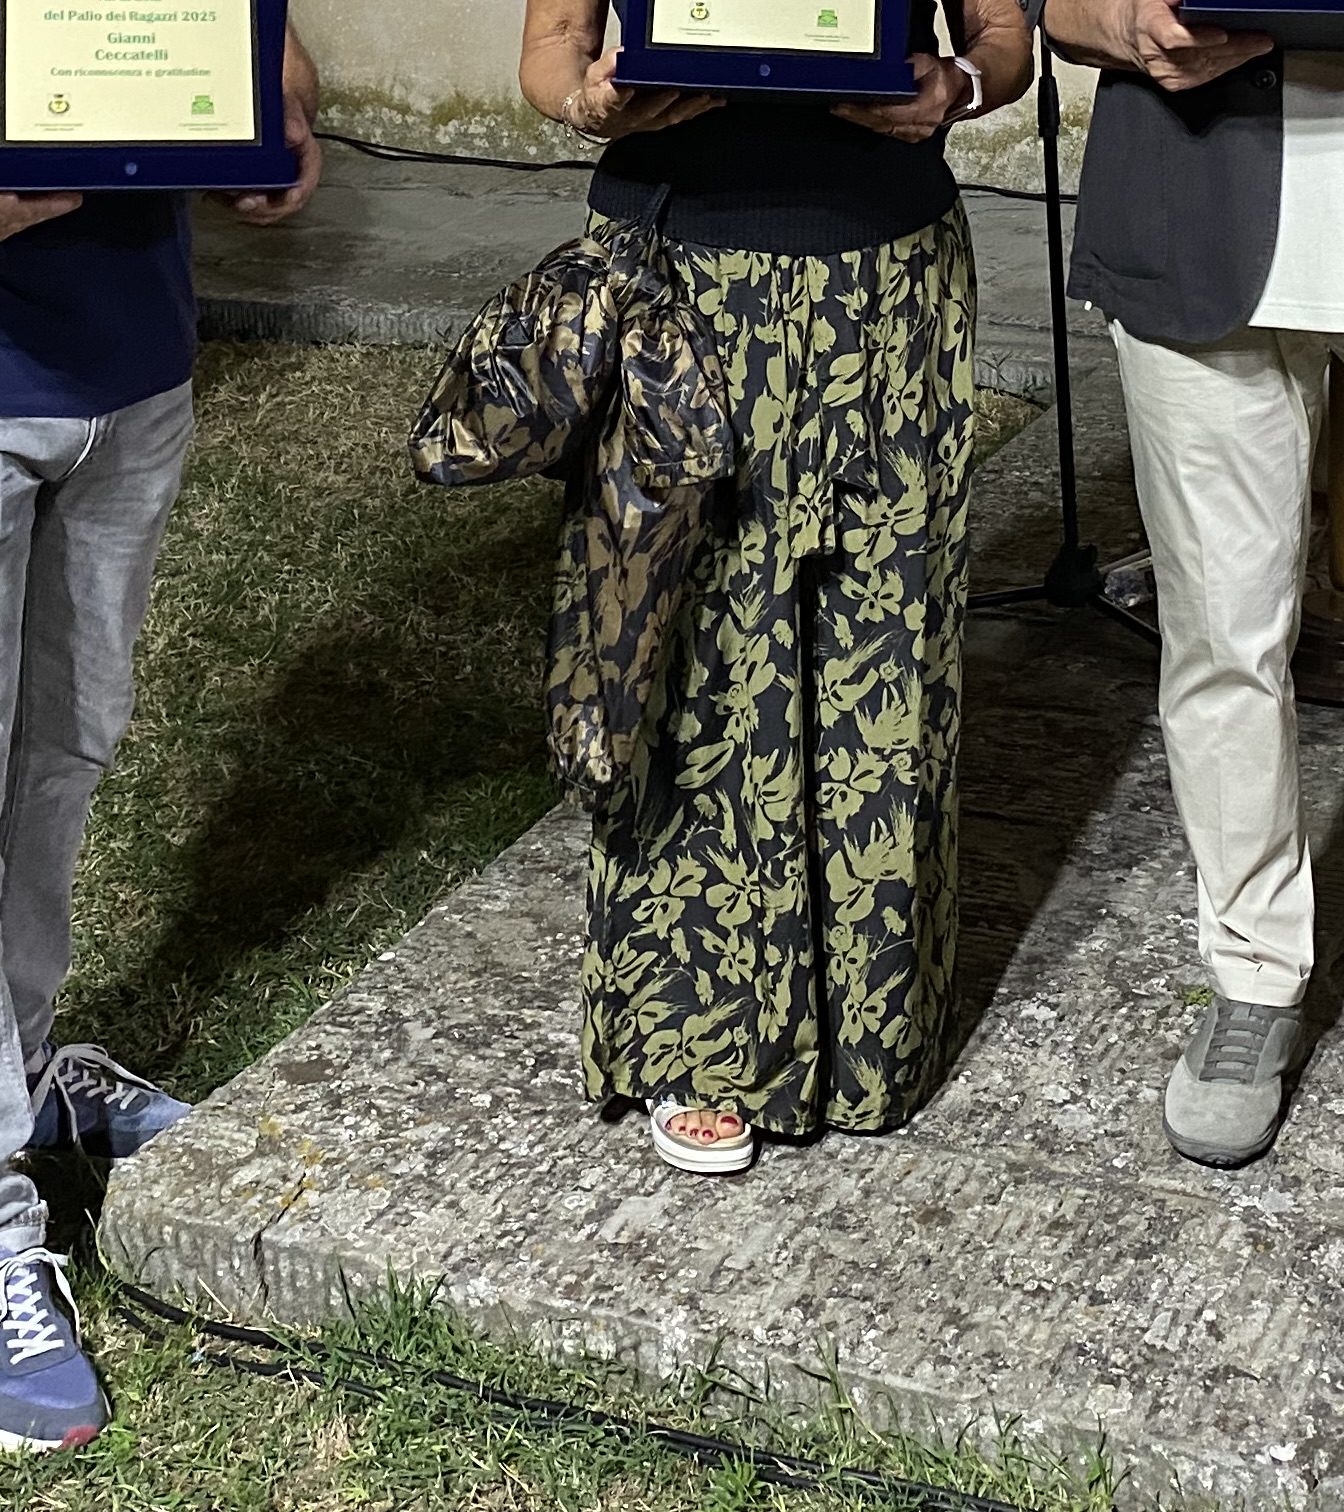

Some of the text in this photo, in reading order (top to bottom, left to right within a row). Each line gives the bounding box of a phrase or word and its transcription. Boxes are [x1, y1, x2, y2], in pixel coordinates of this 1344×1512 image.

[44, 10, 216, 24] del Palio dei Ragazzi 2025
[107, 32, 156, 44] Gianni
[95, 49, 169, 61] Ceccatelli
